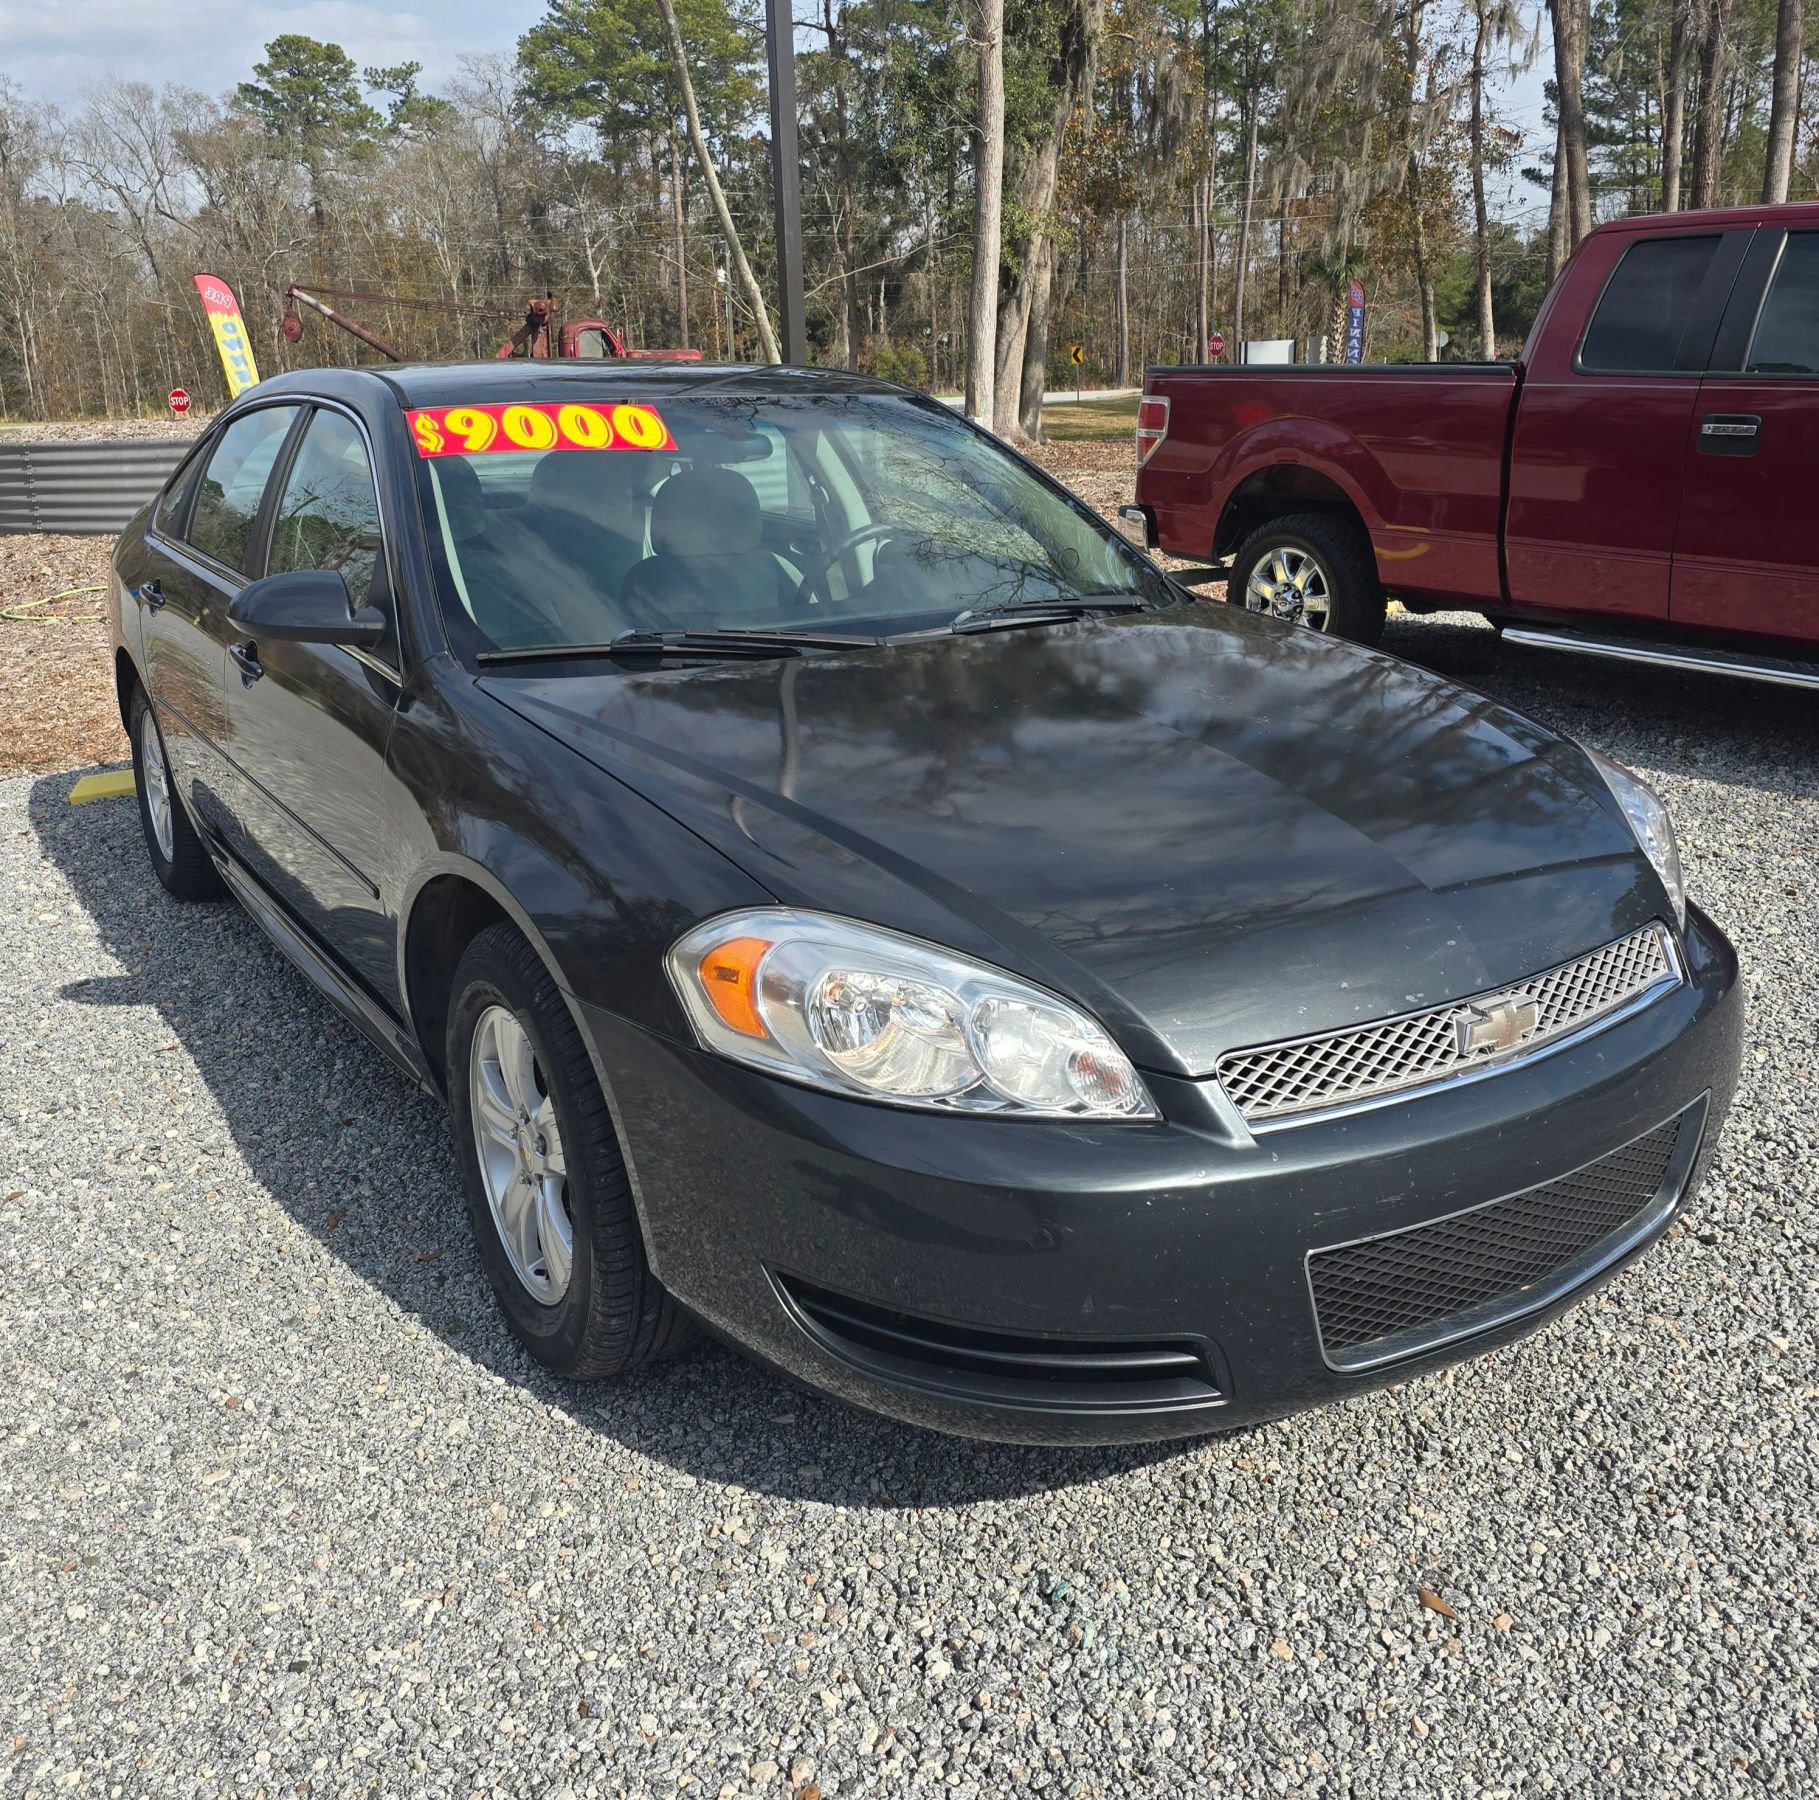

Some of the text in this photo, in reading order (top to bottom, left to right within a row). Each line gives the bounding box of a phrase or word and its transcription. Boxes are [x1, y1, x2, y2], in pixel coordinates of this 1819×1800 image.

[1210, 342, 1223, 351] STOP
[170, 396, 189, 406] STOP
[415, 404, 668, 453] $9000
